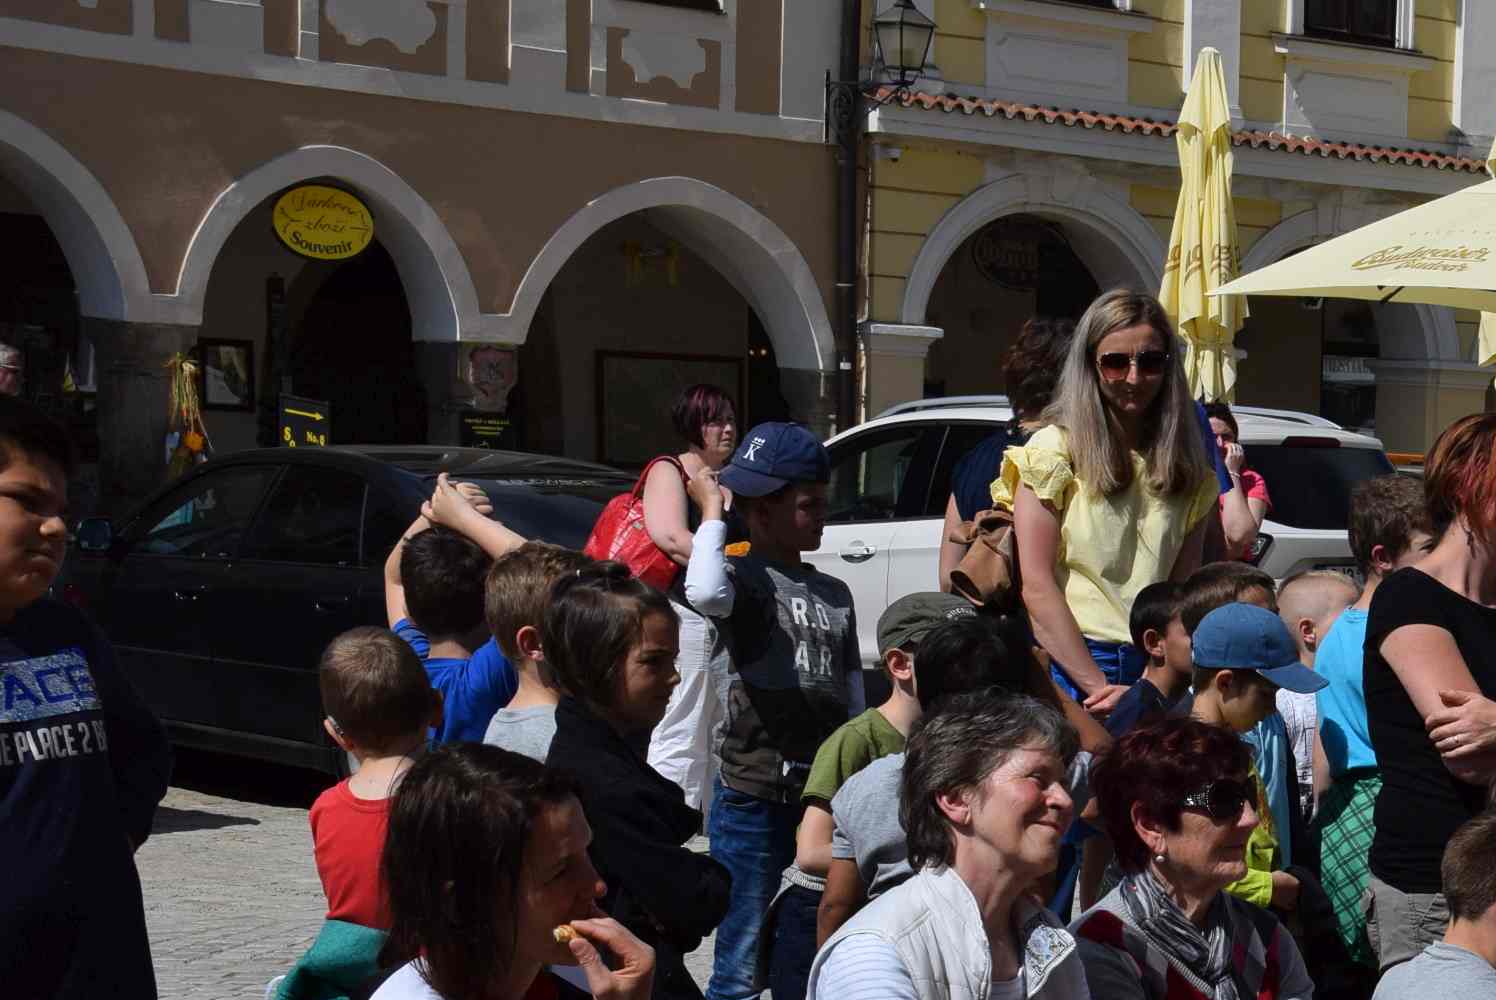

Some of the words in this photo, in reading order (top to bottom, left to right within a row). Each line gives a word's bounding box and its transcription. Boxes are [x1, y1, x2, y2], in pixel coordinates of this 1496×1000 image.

[291, 231, 354, 255] Souvenir
[13, 723, 79, 764] PLACE
[77, 722, 94, 753] 2
